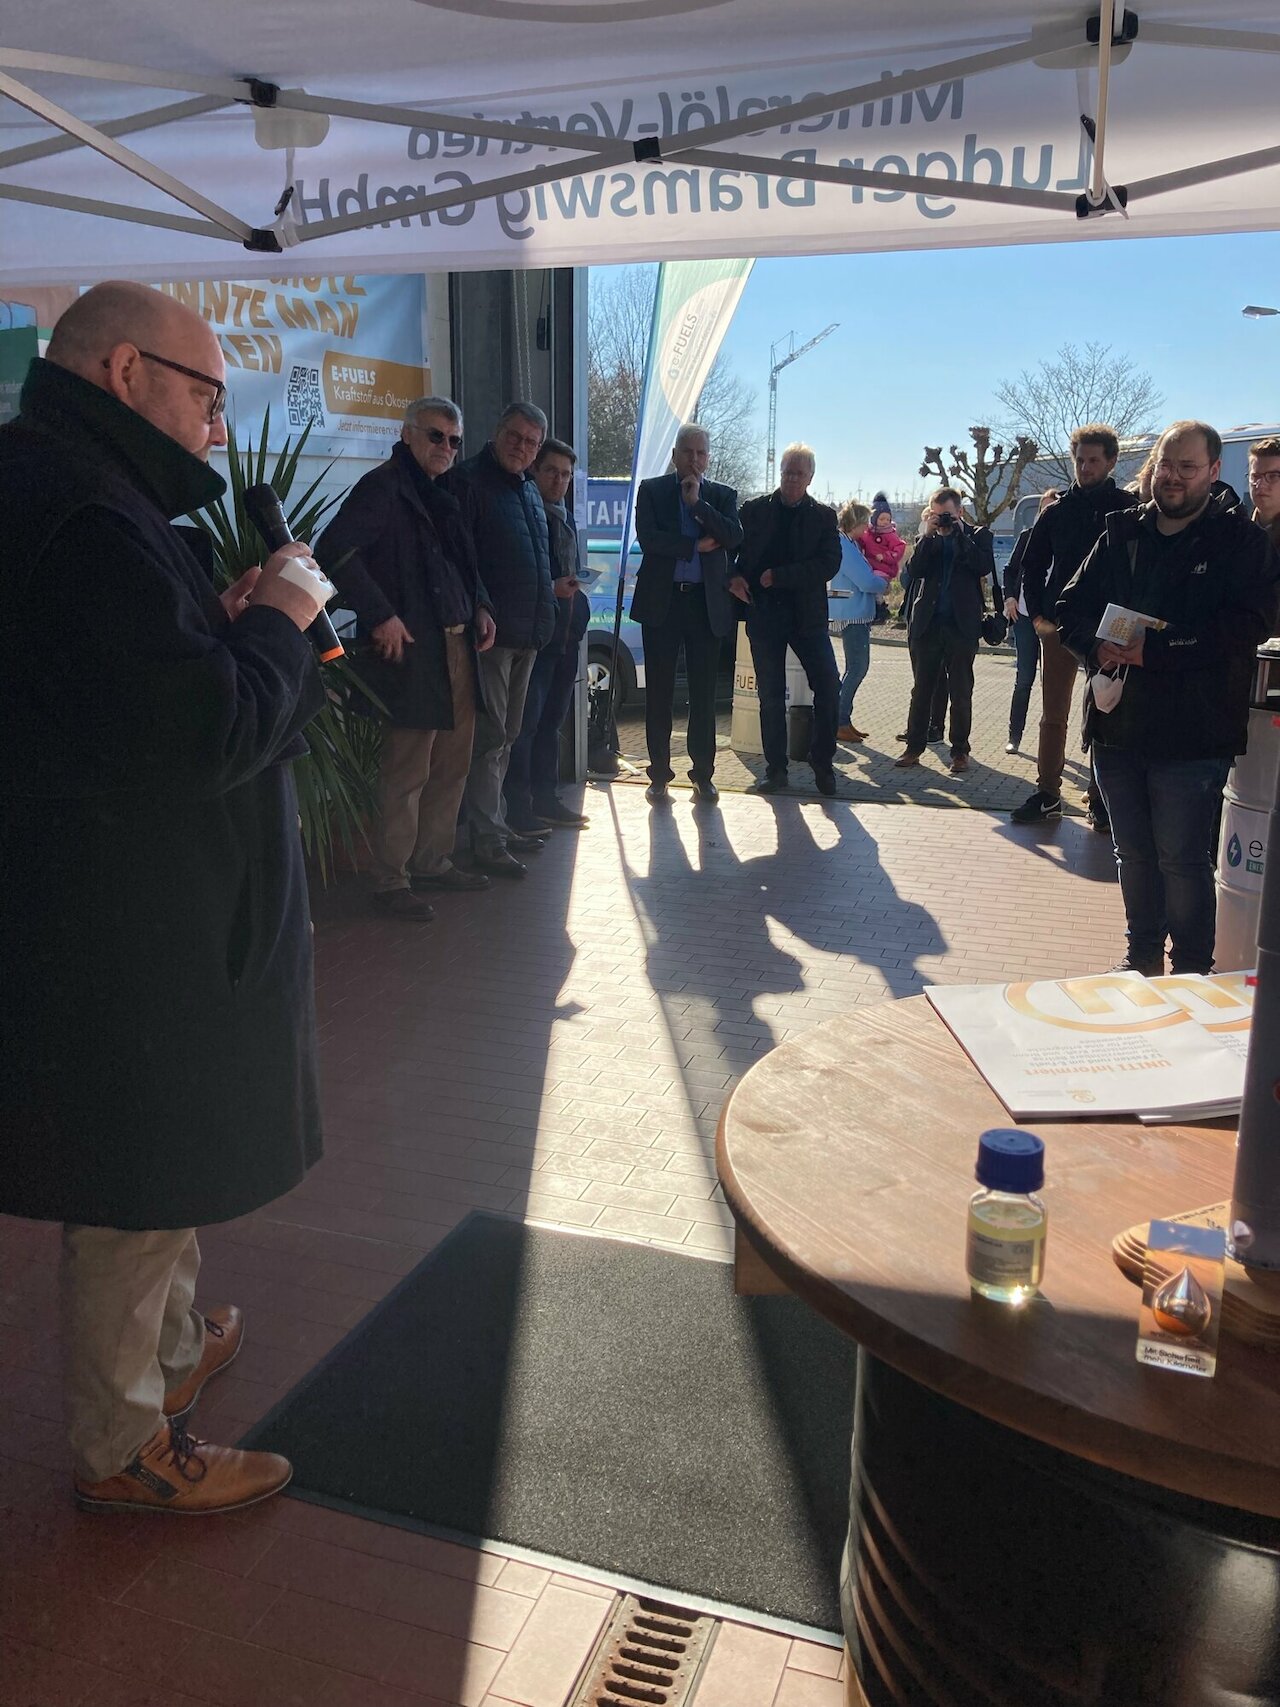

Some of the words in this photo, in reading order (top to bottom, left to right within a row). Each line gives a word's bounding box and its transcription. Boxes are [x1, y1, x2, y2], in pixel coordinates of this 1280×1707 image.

[274, 294, 360, 339] MAN
[331, 365, 376, 386] E-FUELS
[333, 385, 373, 404] Kraftstoff
[372, 394, 384, 407] aus
